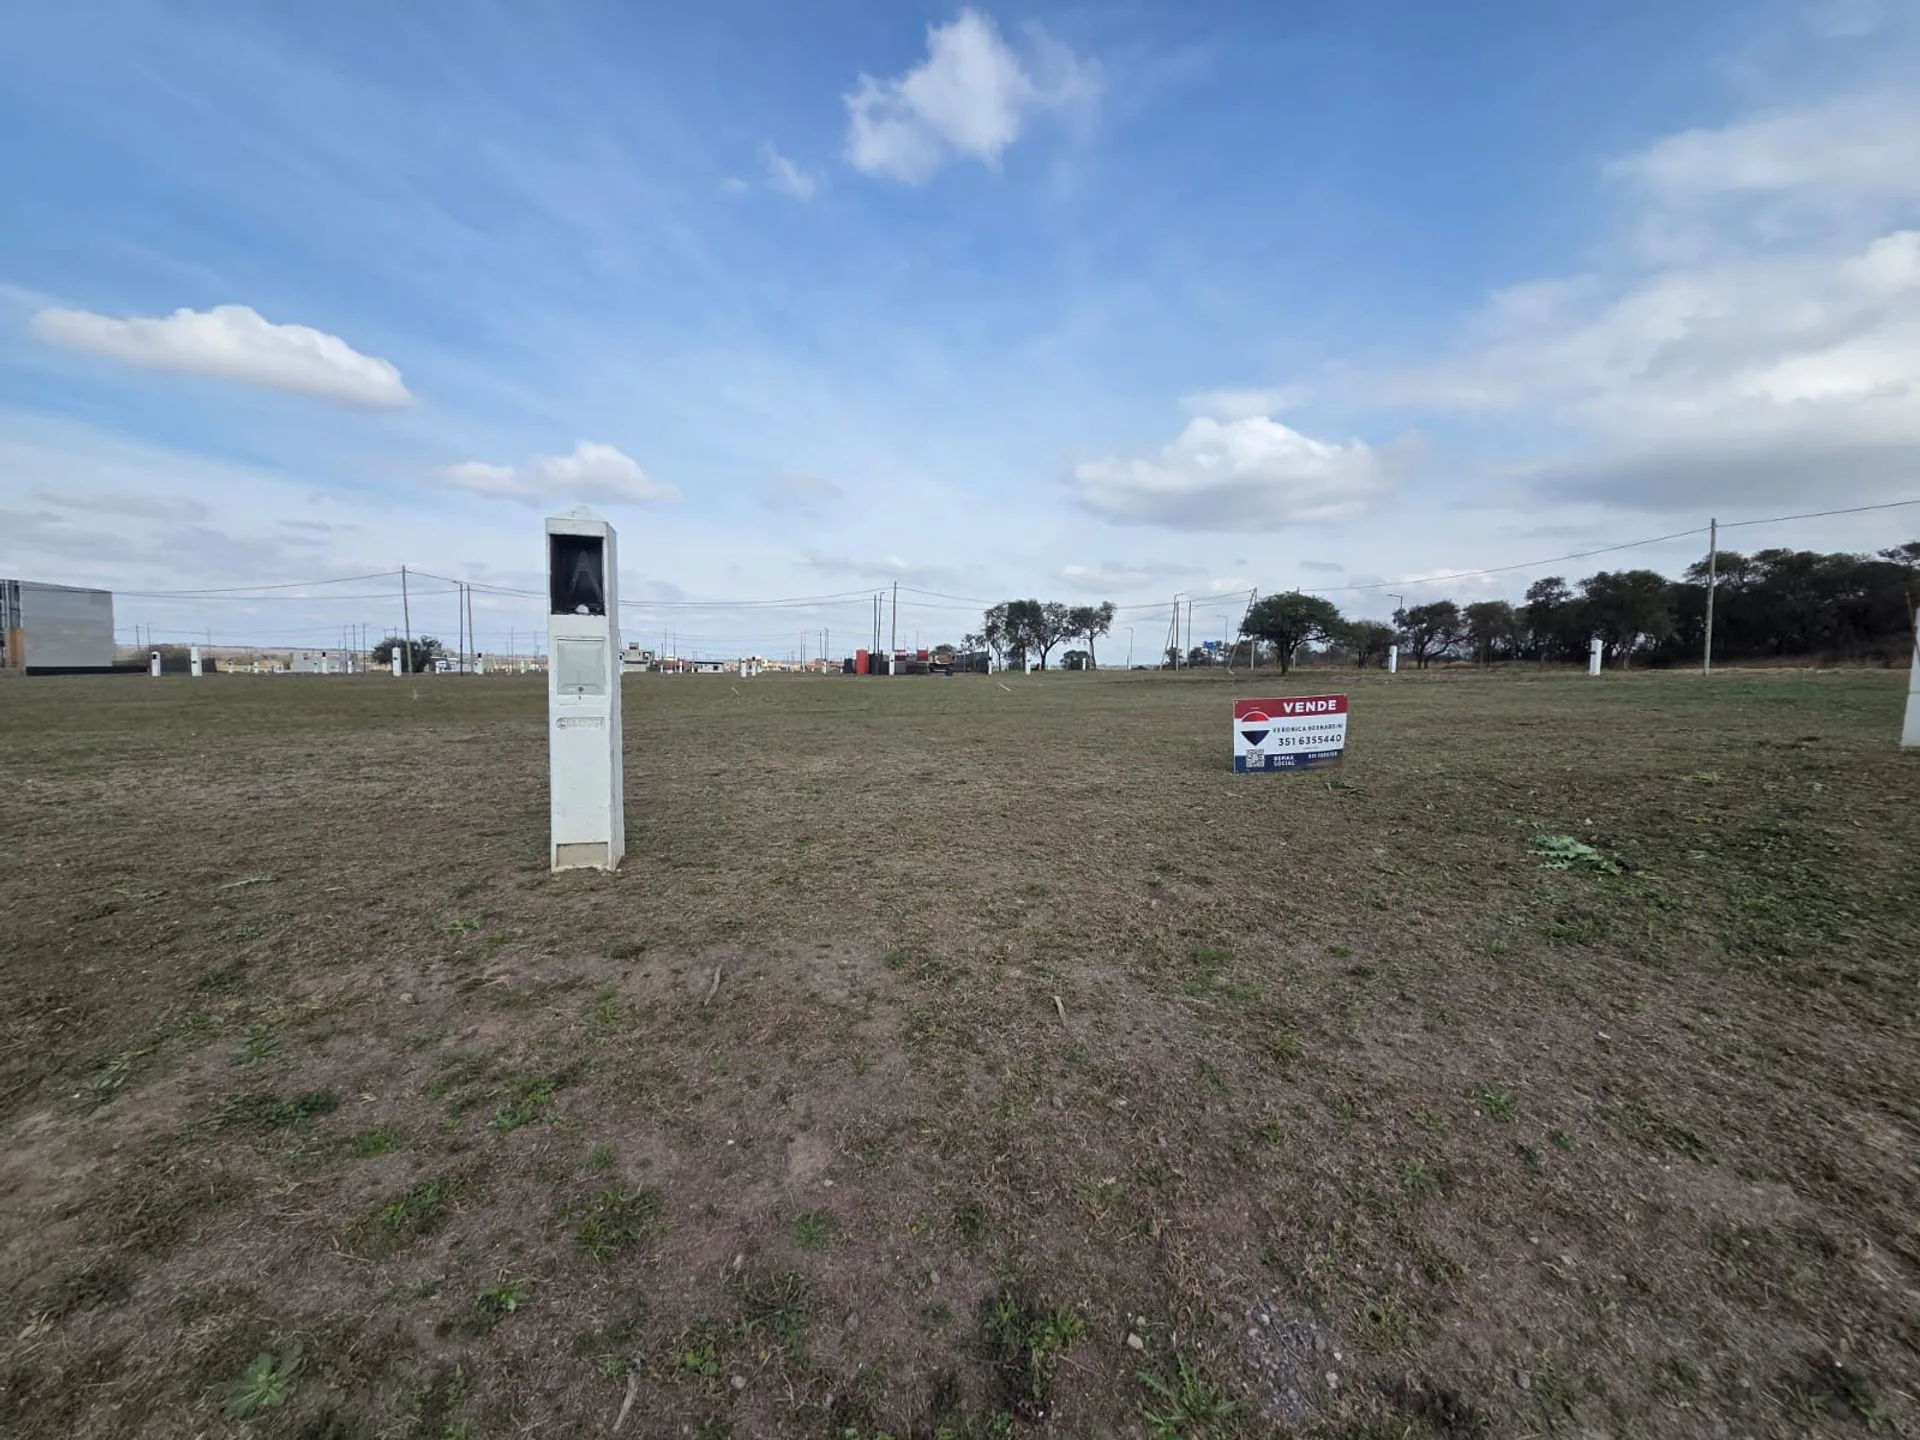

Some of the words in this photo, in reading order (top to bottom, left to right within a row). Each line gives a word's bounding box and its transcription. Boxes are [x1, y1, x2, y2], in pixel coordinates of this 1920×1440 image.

[1283, 700, 1337, 713] VENDE
[1278, 737, 1296, 746] 351
[1298, 734, 1342, 745] 6355440
